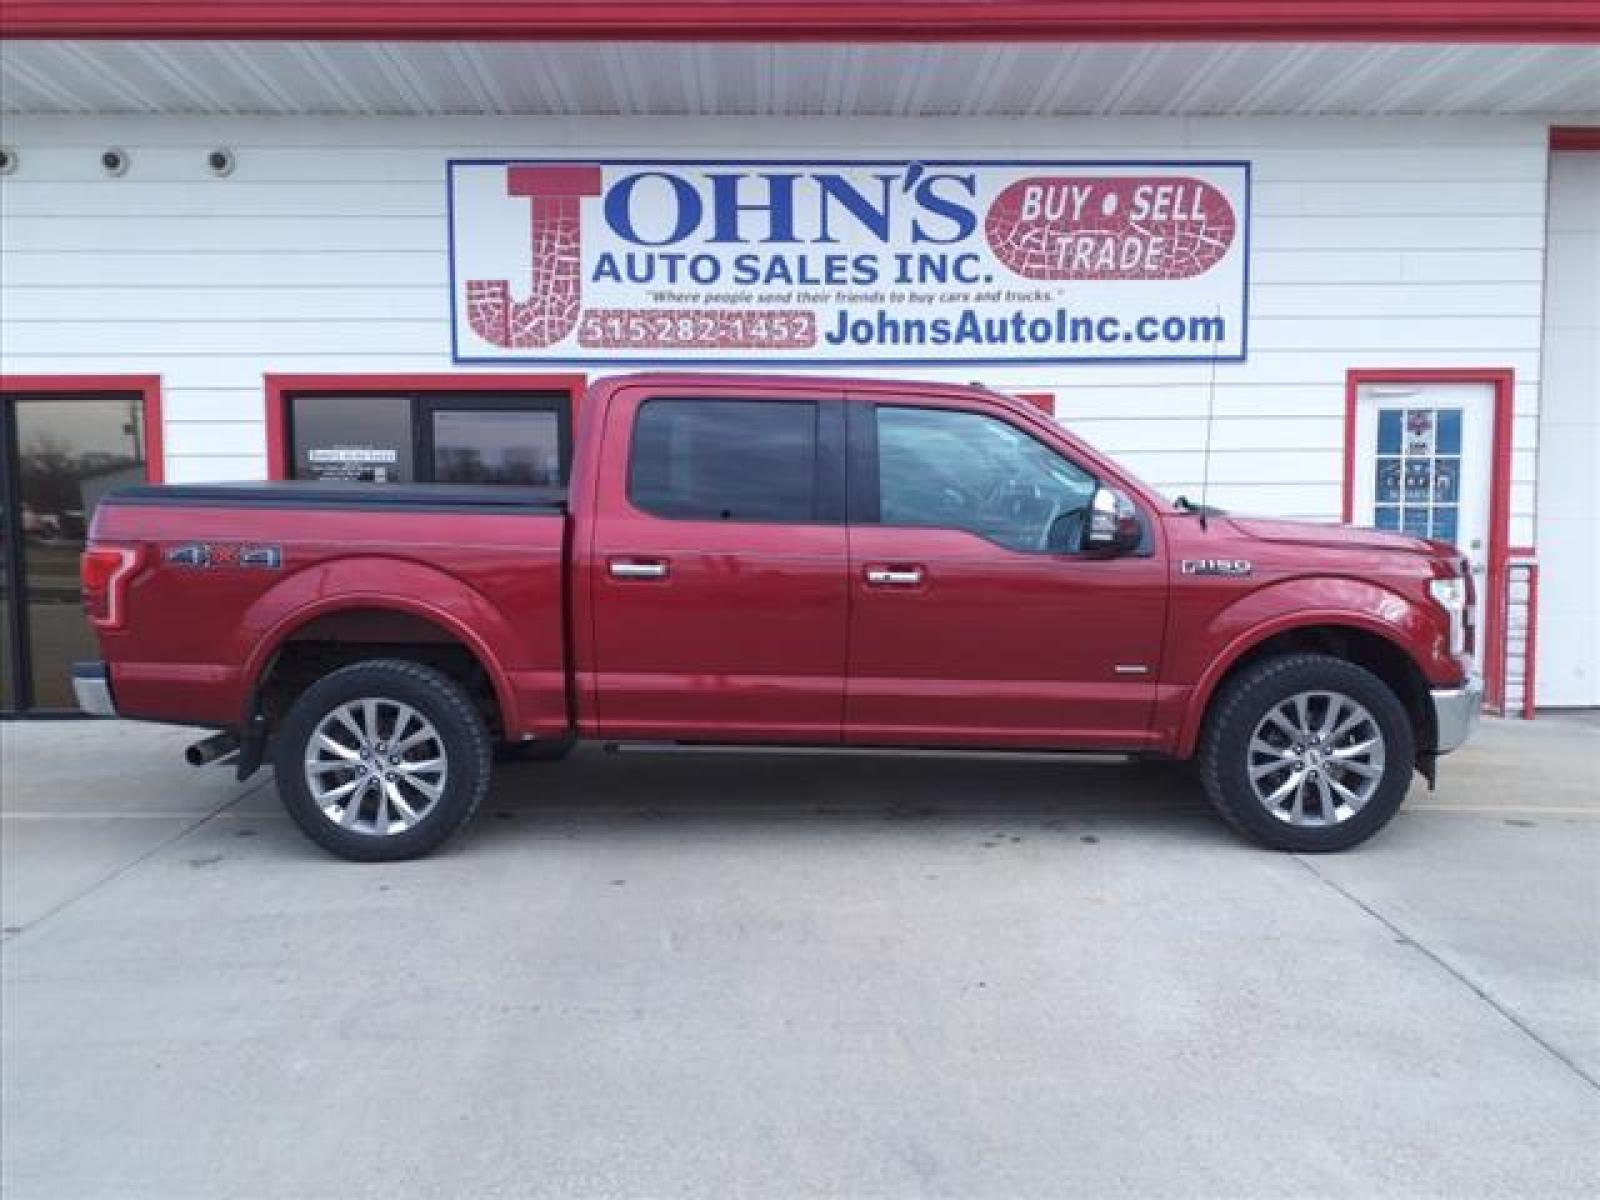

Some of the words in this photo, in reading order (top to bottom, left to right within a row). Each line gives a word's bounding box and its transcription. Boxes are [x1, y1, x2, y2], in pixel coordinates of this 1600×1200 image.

[1021, 184, 1092, 221] BUY
[1129, 184, 1206, 221] SELL
[466, 163, 977, 348] JOHN'S
[592, 252, 721, 284] AUTO
[732, 253, 878, 286] SALES
[894, 253, 994, 284] INC.
[1055, 236, 1166, 271] TRADE
[704, 289, 753, 305] people
[758, 289, 793, 302] send
[797, 289, 830, 302] their
[834, 289, 886, 303] friends
[889, 290, 906, 303] to
[909, 290, 936, 305] buy
[939, 291, 969, 303] cars
[973, 289, 1001, 303] and
[824, 308, 1226, 346] JohnsAutoInc.com
